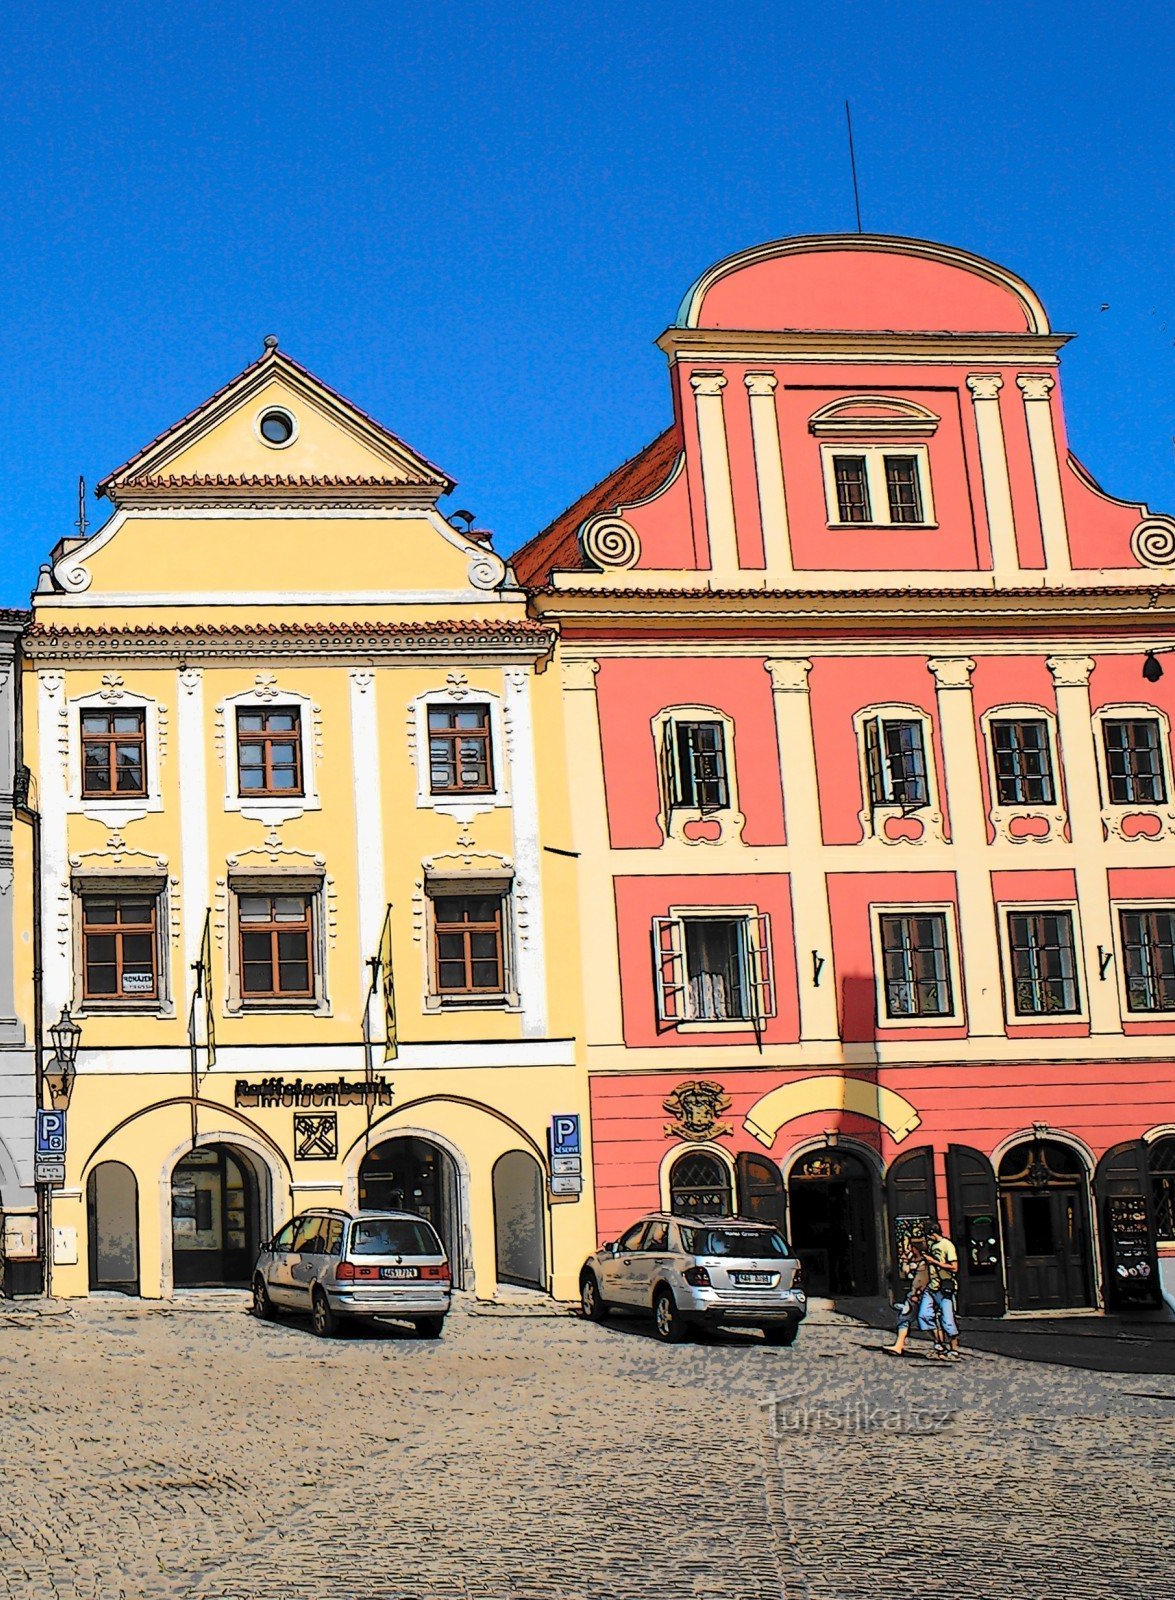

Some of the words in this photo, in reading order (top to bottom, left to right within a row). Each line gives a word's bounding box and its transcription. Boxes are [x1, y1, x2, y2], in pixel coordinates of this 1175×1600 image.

[235, 1076, 395, 1096] Raiffeisenbank
[42, 1115, 60, 1141] P
[557, 1119, 575, 1145] P
